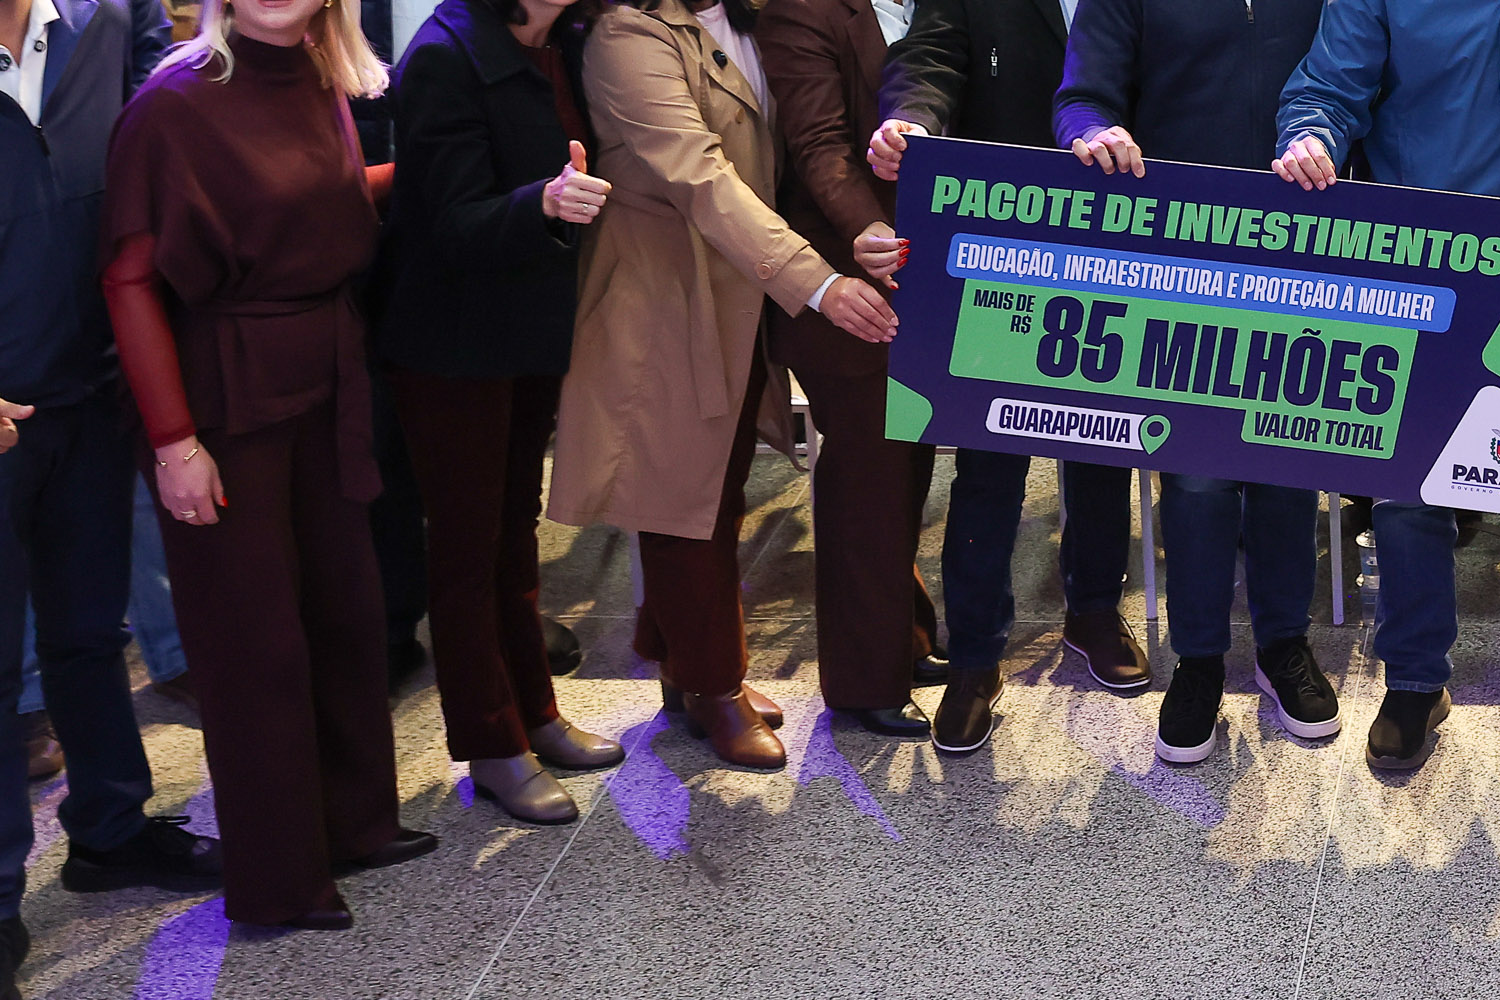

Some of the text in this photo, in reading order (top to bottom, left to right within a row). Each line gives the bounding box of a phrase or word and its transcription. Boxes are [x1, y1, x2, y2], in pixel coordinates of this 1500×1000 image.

[930, 175, 1095, 229] PACOTE
[1101, 193, 1158, 236] DE
[956, 242, 1435, 321] EDUCAÇÃO, INFRAESTRUTURA E PROTEÇÃO À MULHER
[973, 289, 1036, 313] MAIS DE
[1010, 314, 1032, 335] R$
[1036, 296, 1400, 415] 85 MILHÕES
[999, 404, 1131, 443] GUARAPUAVA
[1254, 411, 1384, 451] VALOR TOTAL
[1451, 485, 1493, 494] GOVERNO
